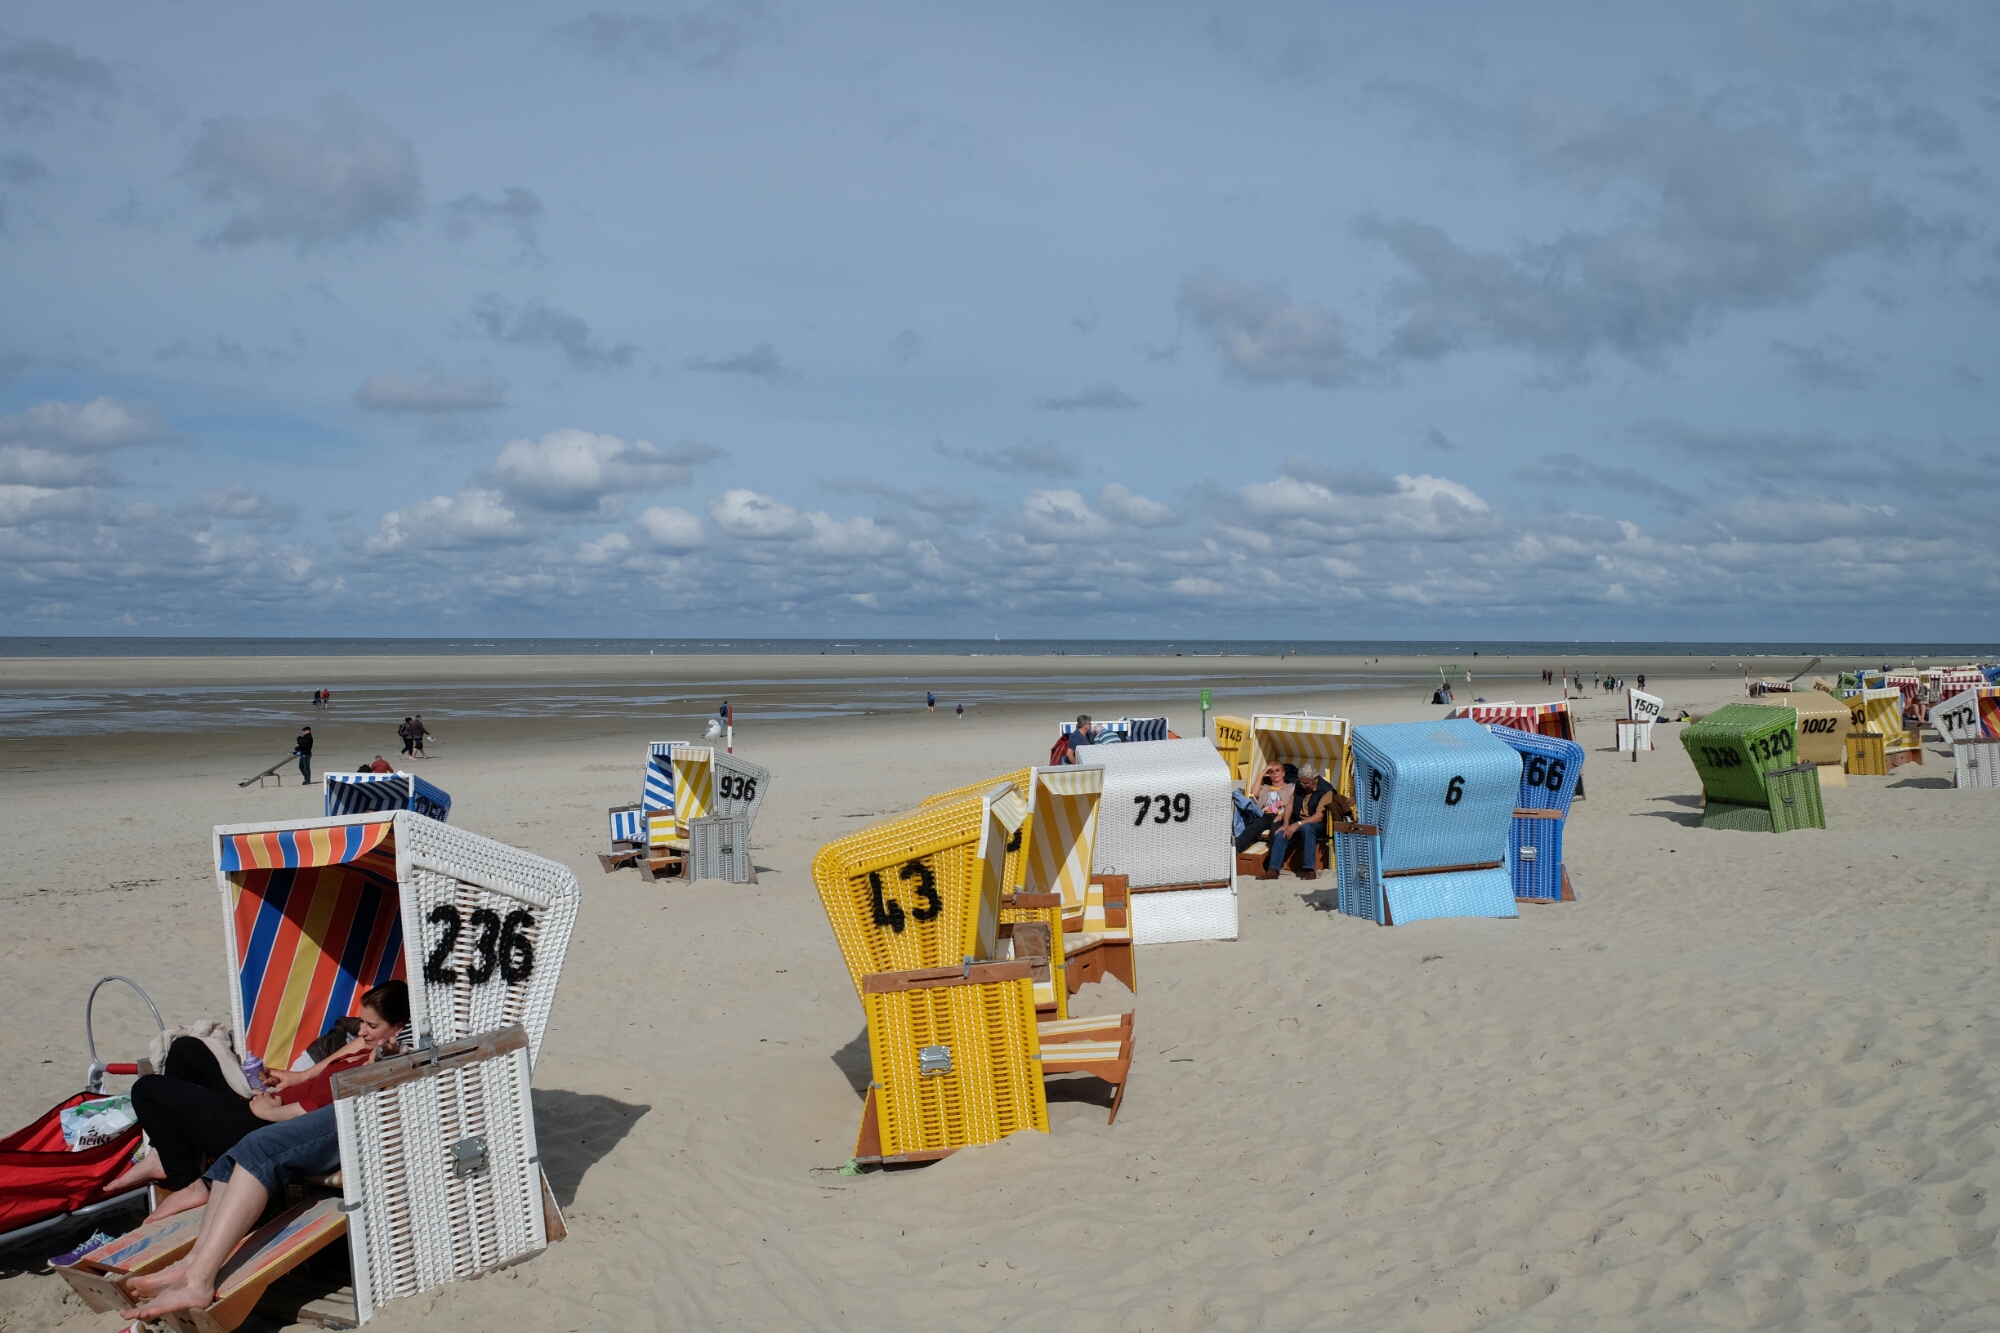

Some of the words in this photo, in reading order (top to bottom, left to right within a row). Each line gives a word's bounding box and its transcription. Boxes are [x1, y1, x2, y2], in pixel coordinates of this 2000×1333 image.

[1634, 699, 1660, 716] 1503
[1942, 707, 1976, 731] 772
[1219, 726, 1243, 742] 1145
[1802, 718, 1837, 734] 1002
[1702, 746, 1742, 768] 1320
[1749, 729, 1793, 763] 1320
[1371, 769, 1382, 801] 6
[1521, 752, 1566, 791] 66
[719, 775, 757, 802] 936
[1445, 775, 1465, 806] 6
[1134, 793, 1191, 826] 739
[869, 861, 942, 933] 43
[423, 904, 535, 986] 236
